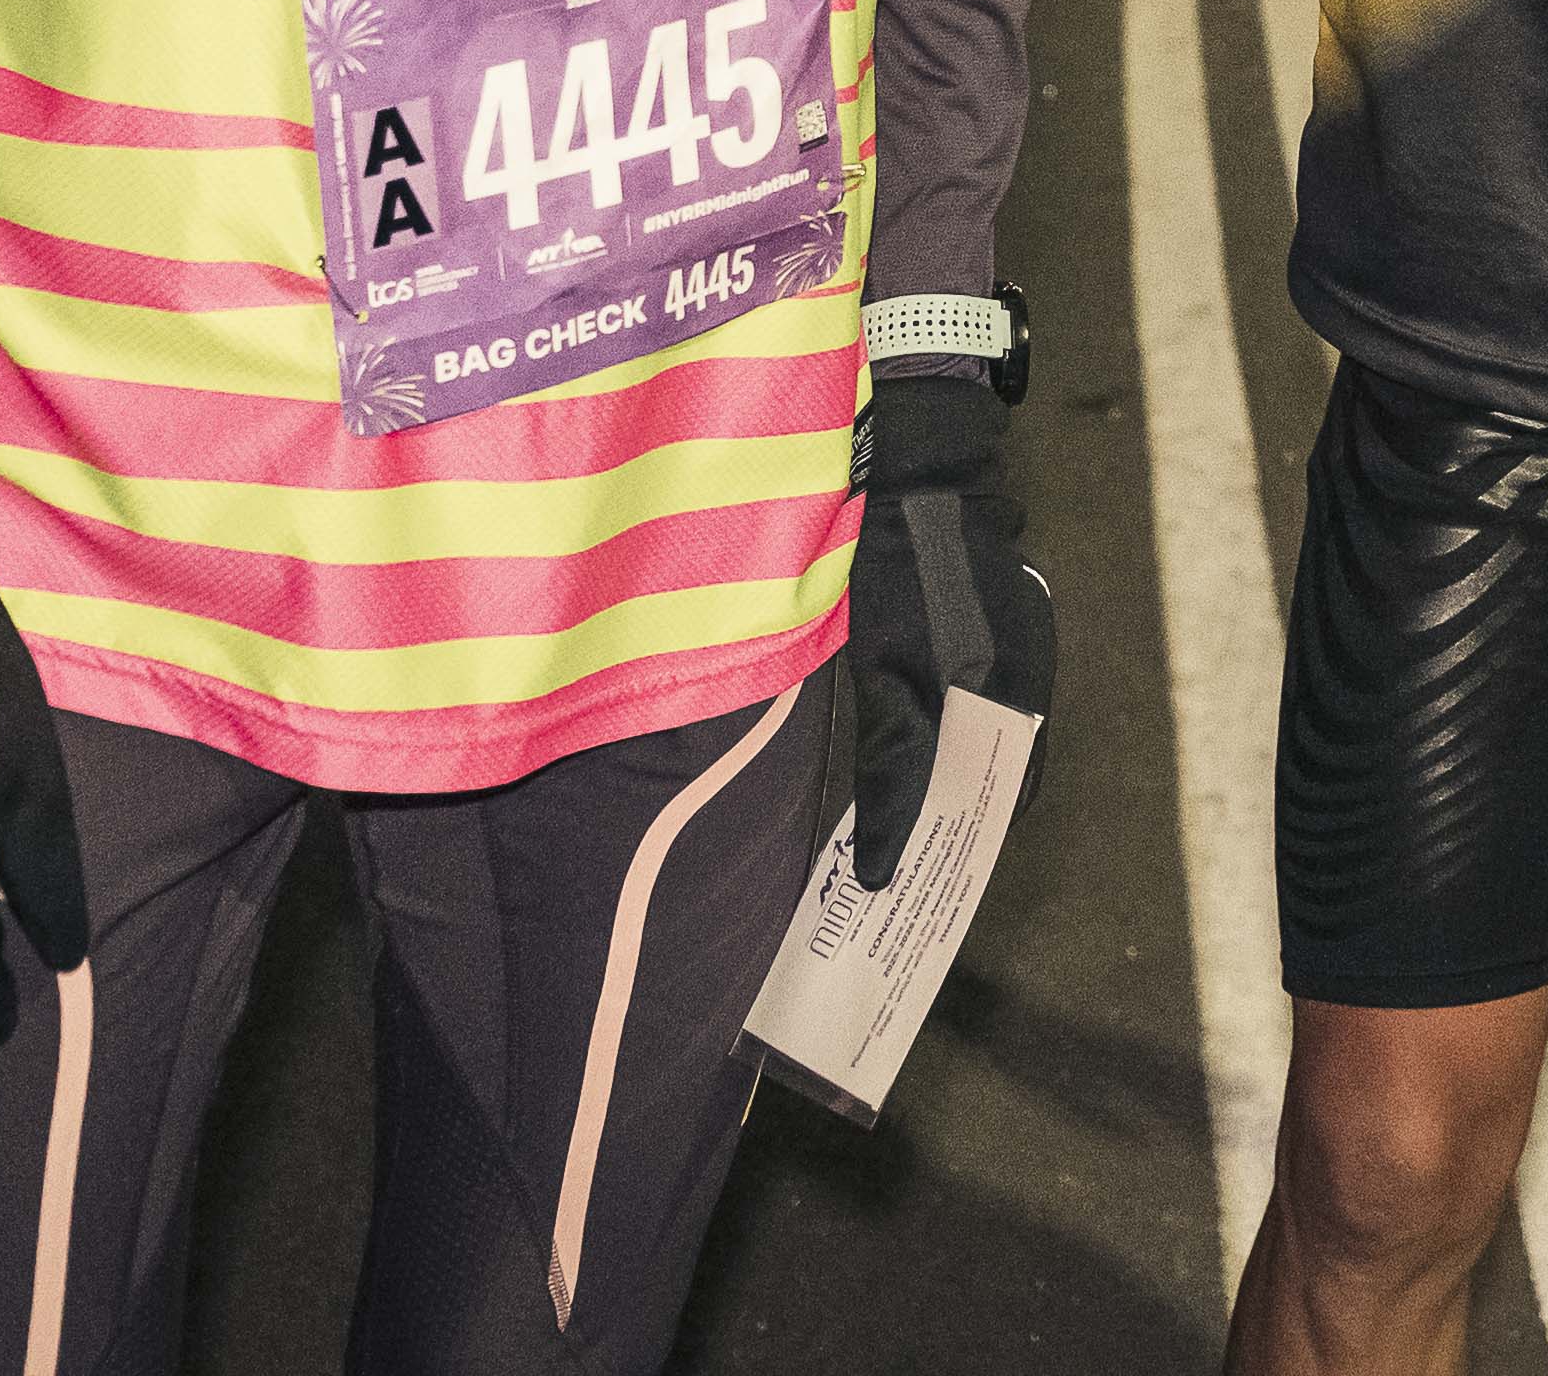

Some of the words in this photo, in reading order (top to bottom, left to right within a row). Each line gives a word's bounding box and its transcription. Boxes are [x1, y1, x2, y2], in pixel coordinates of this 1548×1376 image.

[643, 169, 810, 234] #NYRRMidnightRun
[433, 341, 517, 384] BAG
[524, 295, 647, 361] CHECK
[664, 245, 757, 321] 4445
[866, 814, 946, 959] CONGRATULATIONS!
[938, 905, 960, 943] THANK
